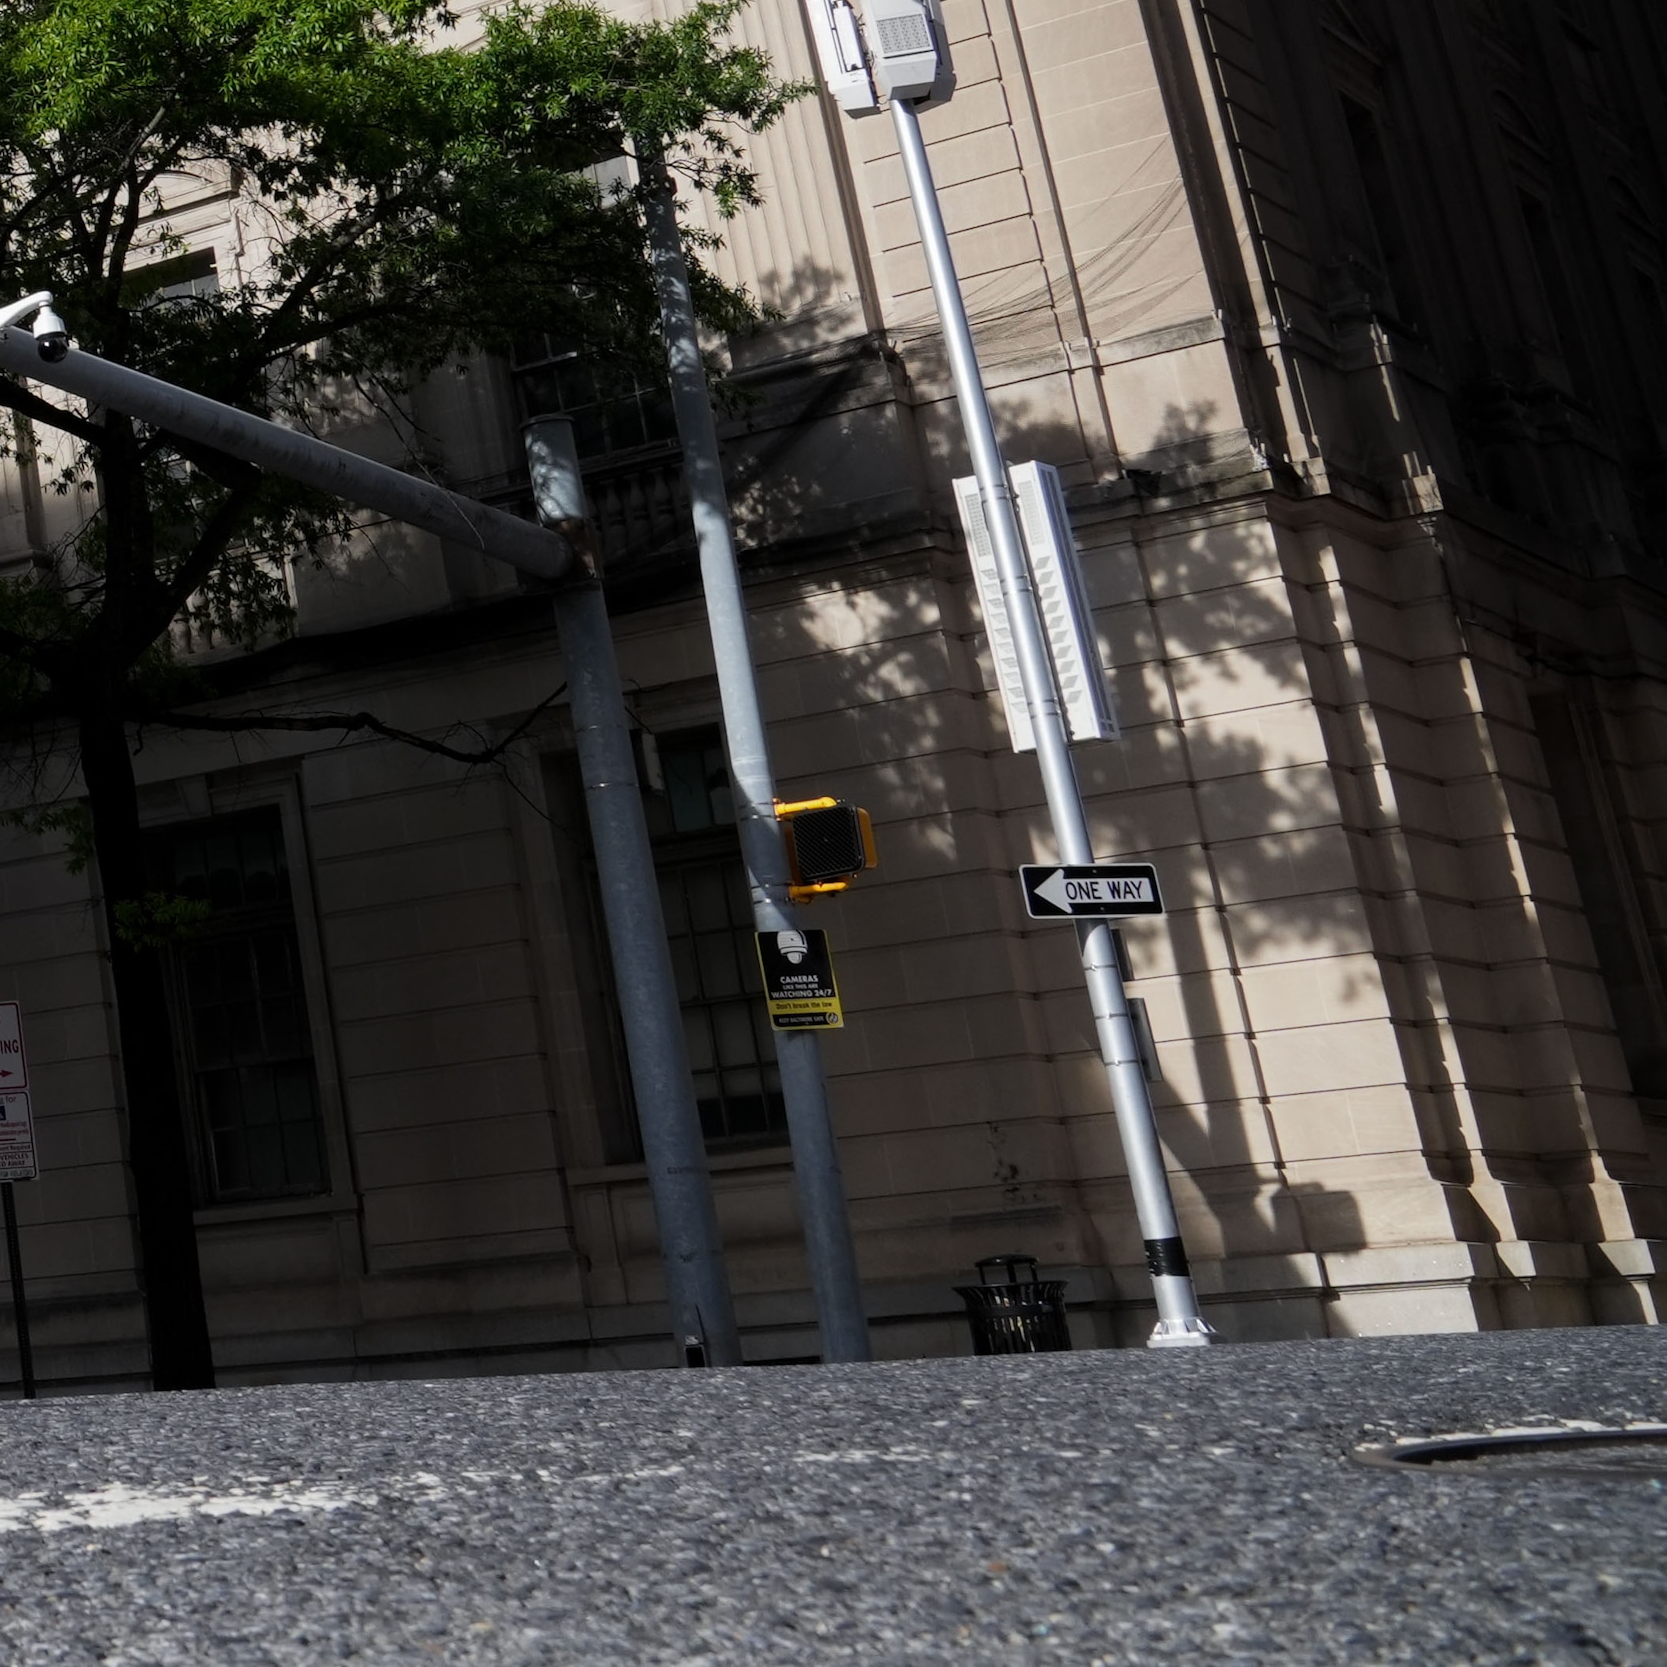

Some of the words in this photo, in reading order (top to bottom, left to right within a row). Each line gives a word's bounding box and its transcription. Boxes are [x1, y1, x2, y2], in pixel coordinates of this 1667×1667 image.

[1065, 882, 1102, 900] ONE
[1109, 881, 1144, 899] WAY
[780, 974, 819, 984] CAMERAS
[770, 990, 813, 999] WATCHING
[814, 989, 833, 997] 24/7
